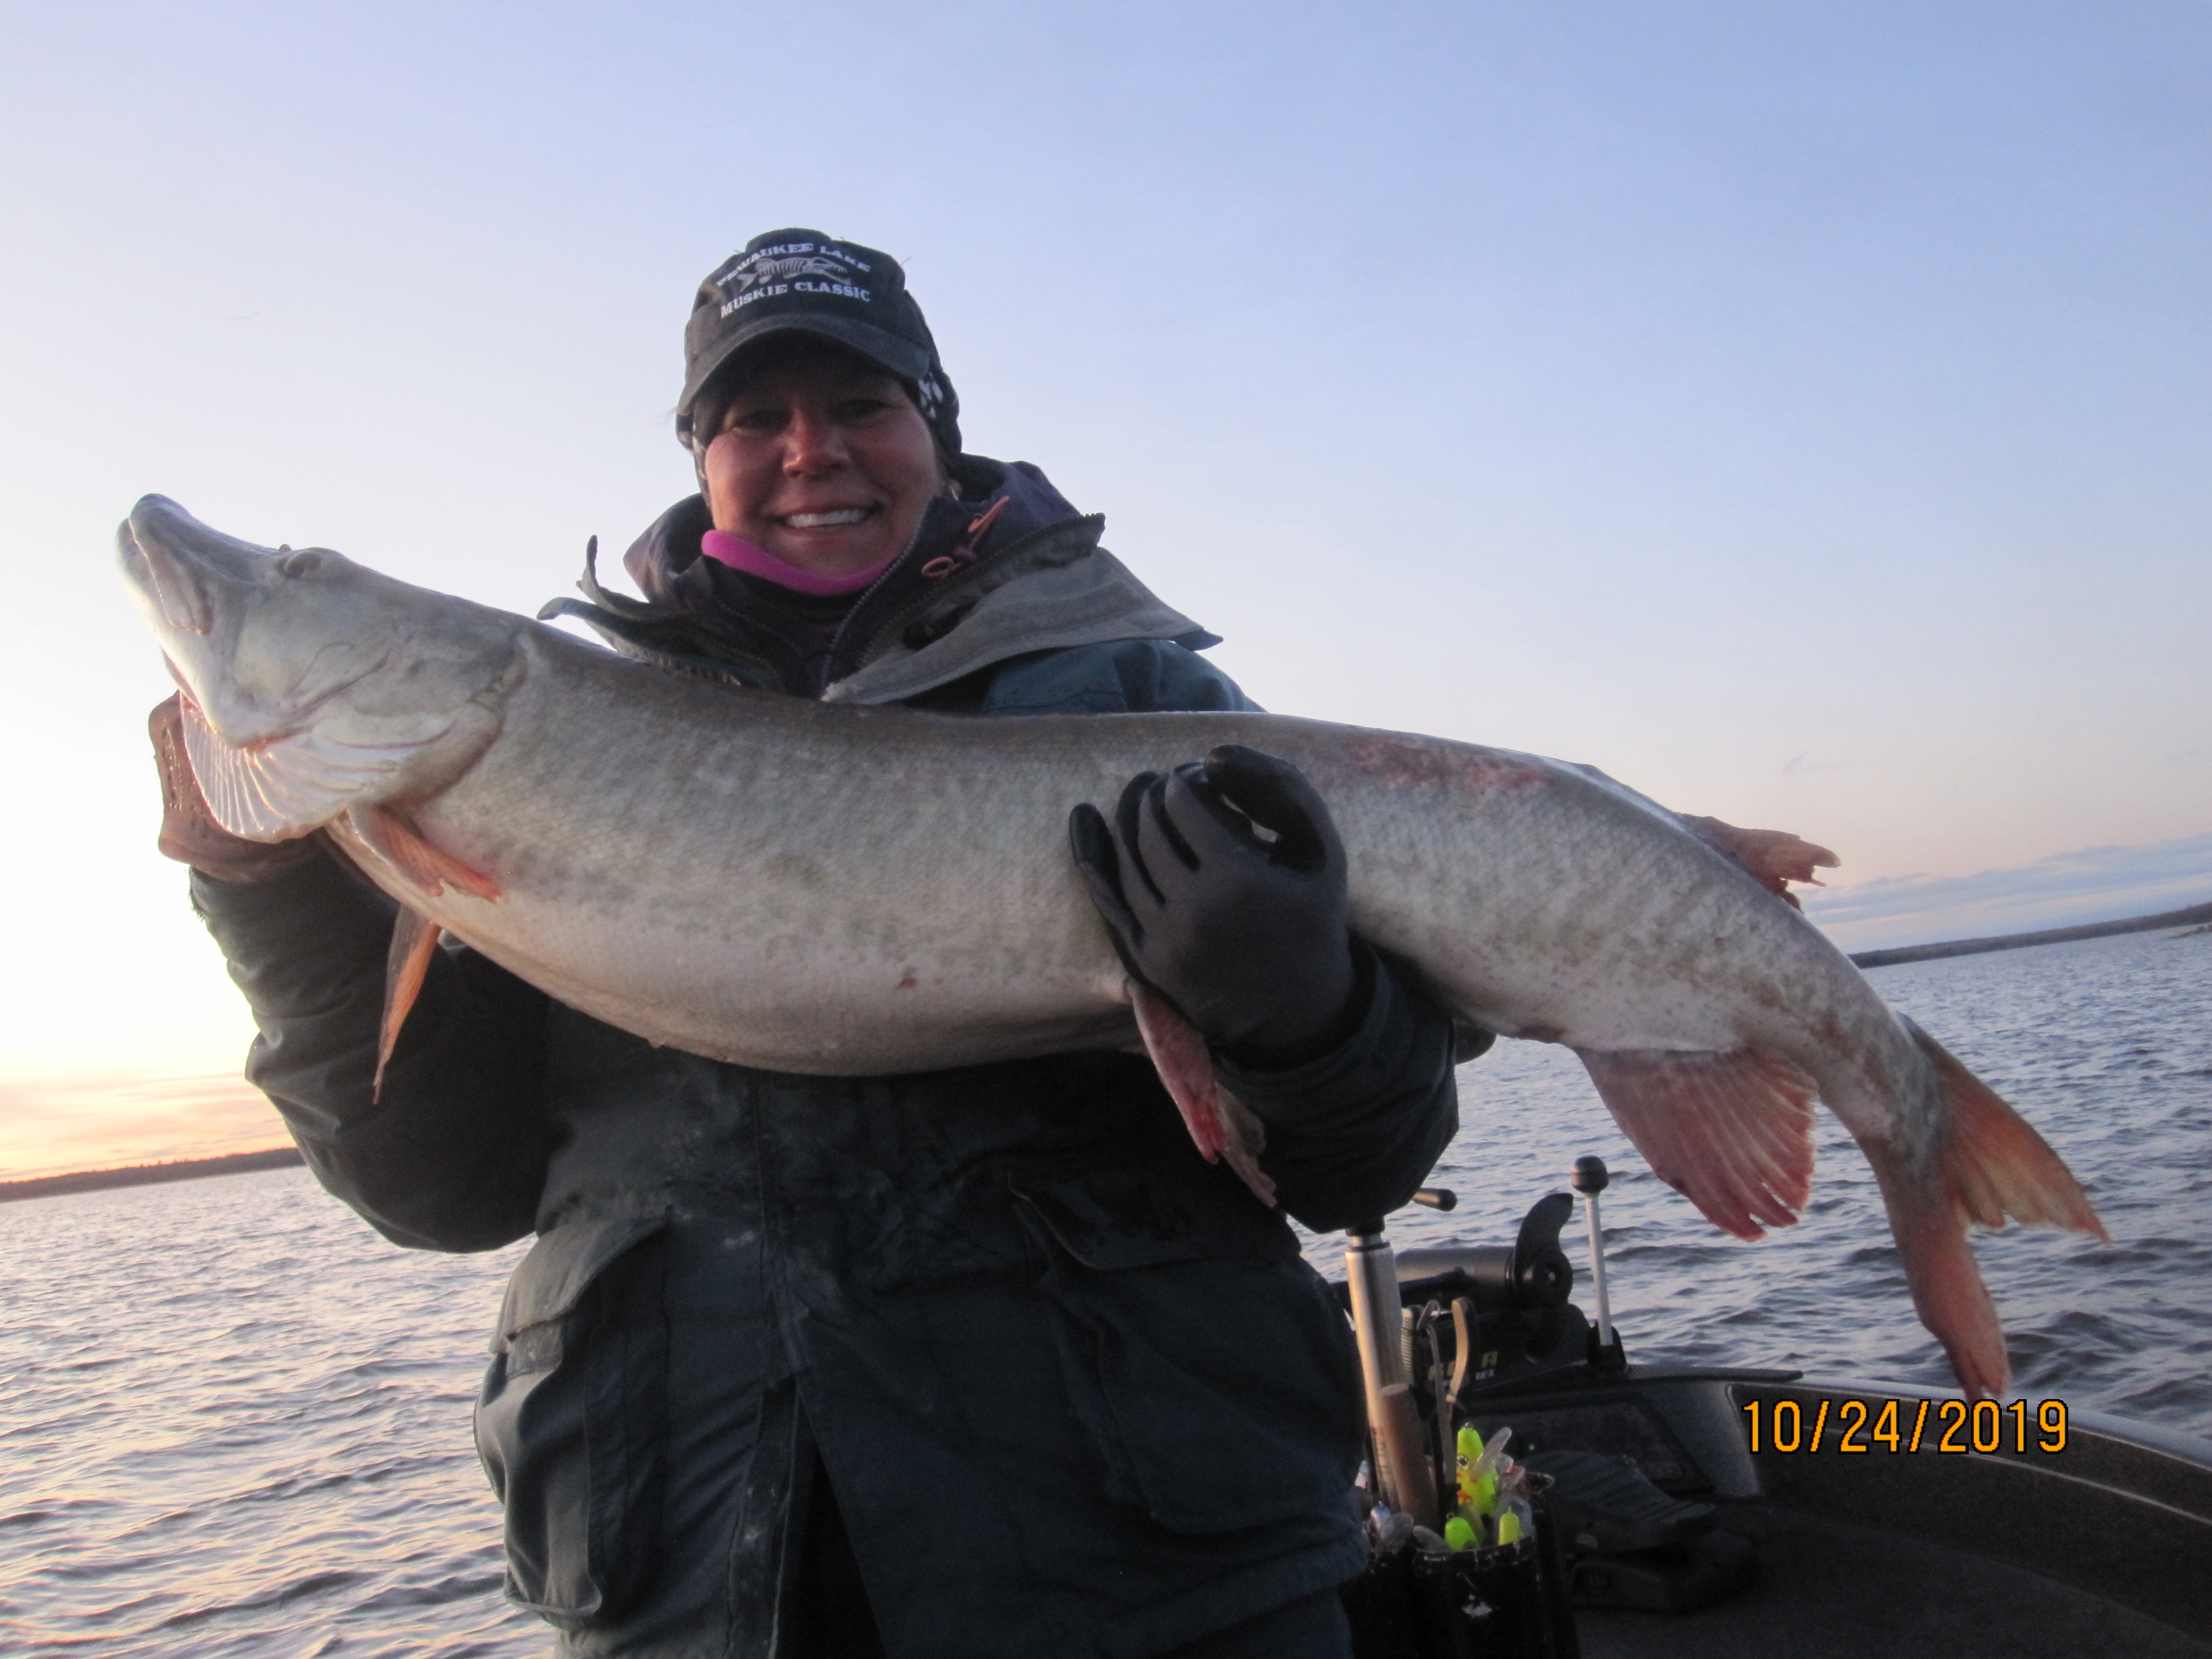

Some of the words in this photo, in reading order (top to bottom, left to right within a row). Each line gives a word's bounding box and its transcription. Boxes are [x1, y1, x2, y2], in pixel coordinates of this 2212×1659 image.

[820, 246, 870, 272] LAKE
[721, 284, 788, 319] MUSKIE
[794, 281, 870, 302] CLASSIC
